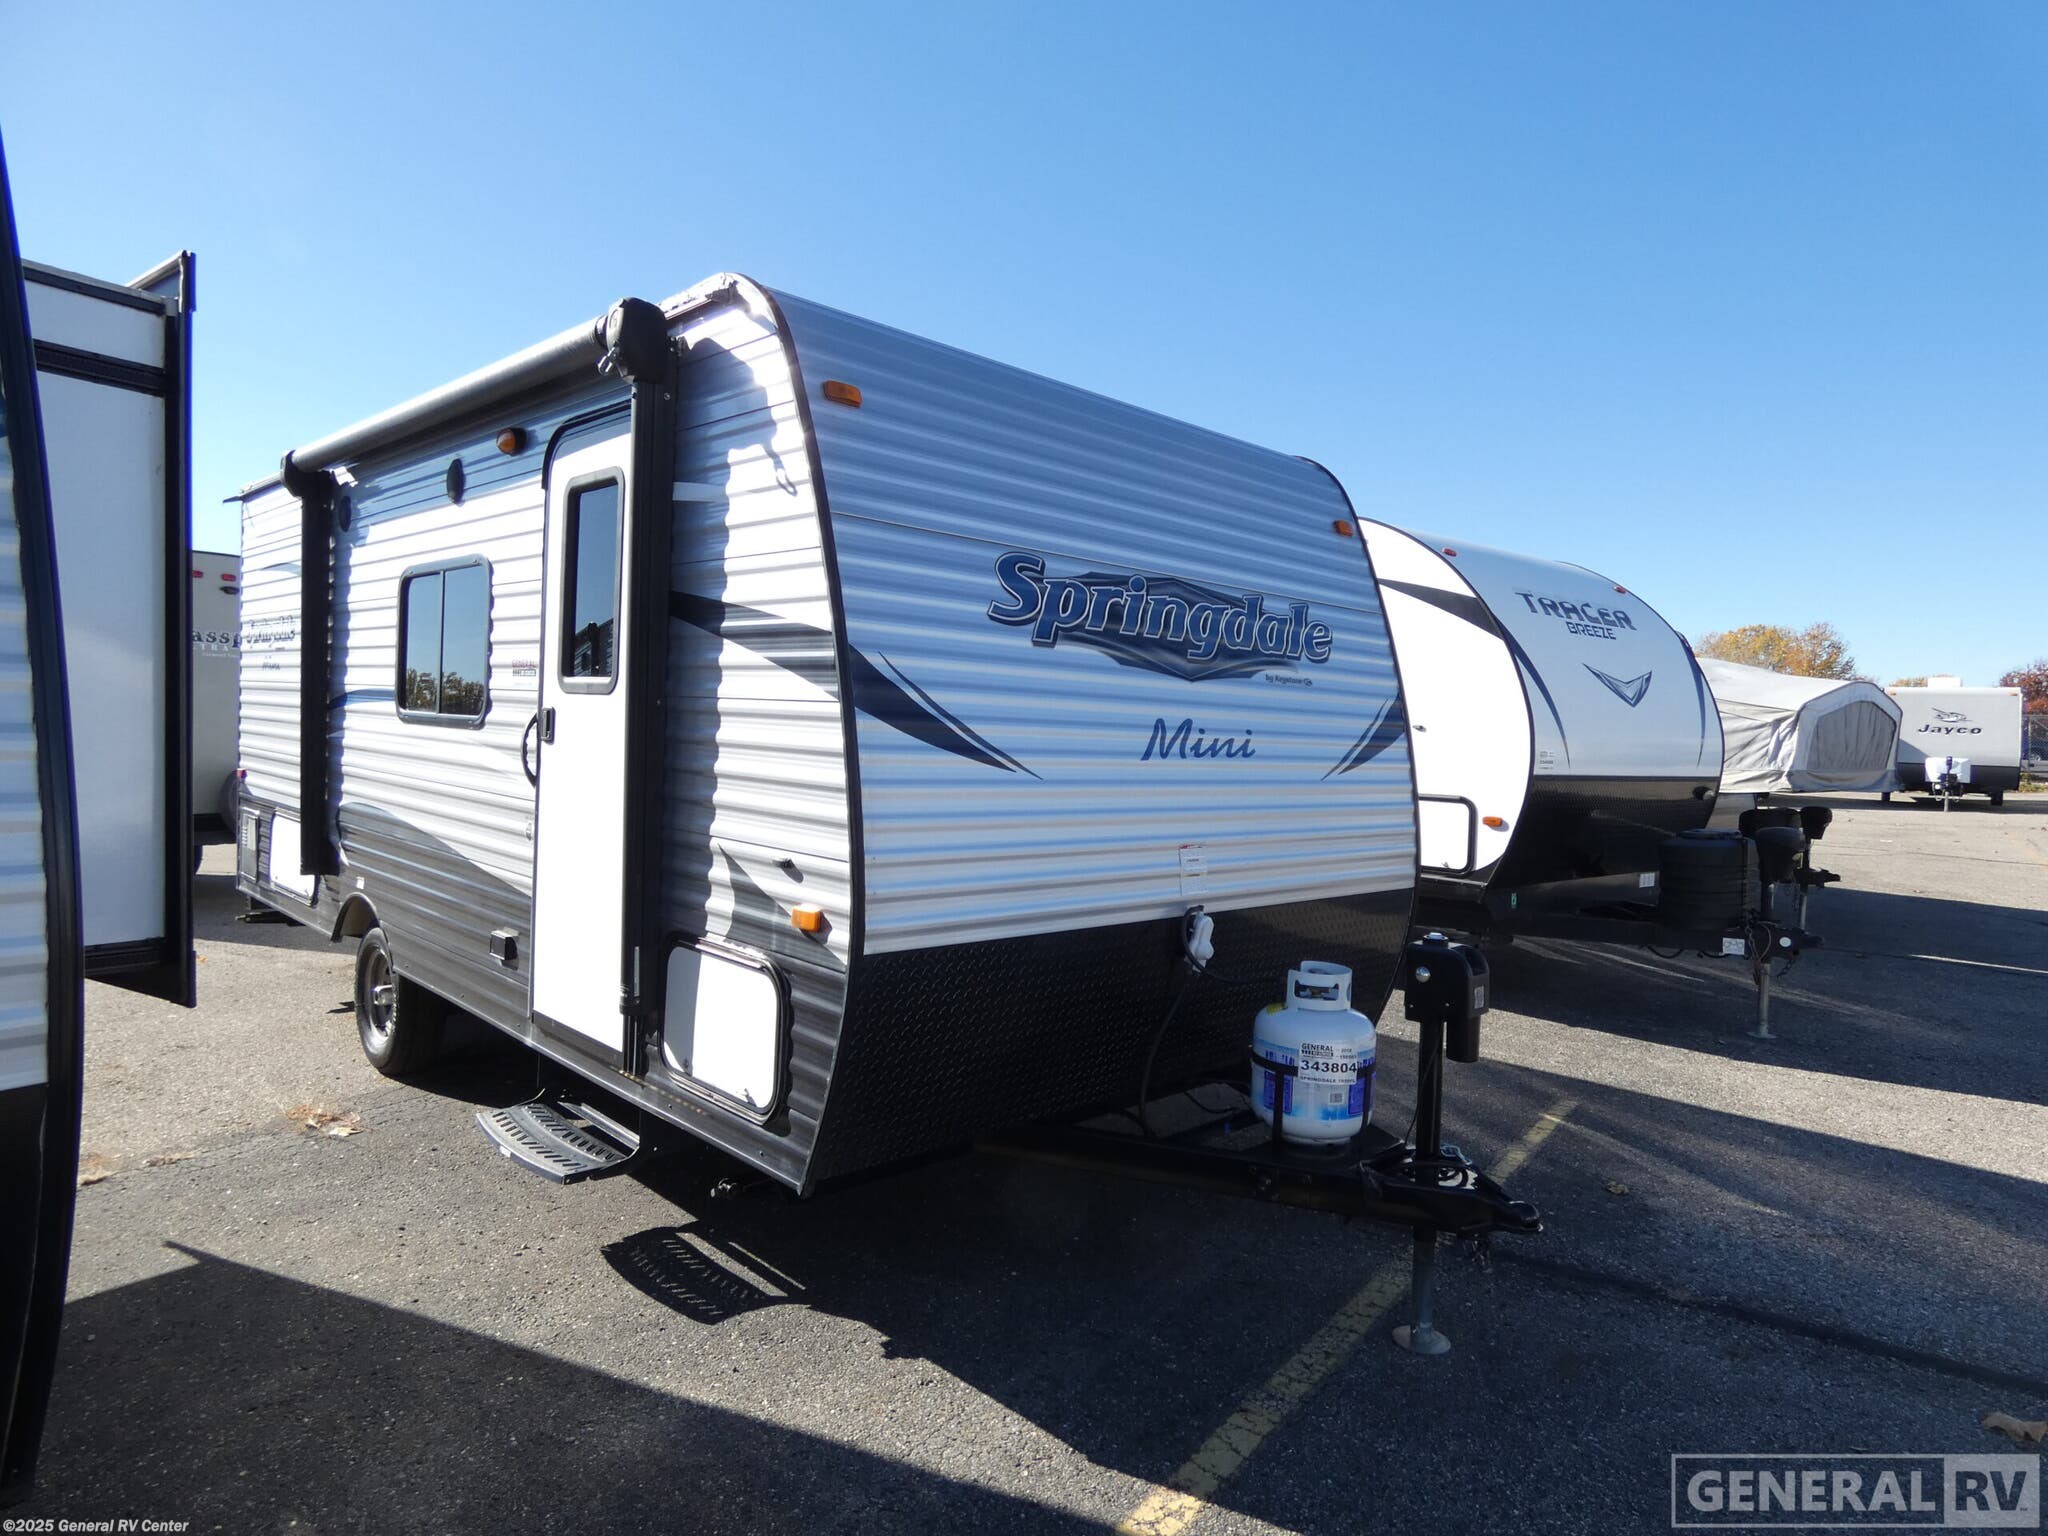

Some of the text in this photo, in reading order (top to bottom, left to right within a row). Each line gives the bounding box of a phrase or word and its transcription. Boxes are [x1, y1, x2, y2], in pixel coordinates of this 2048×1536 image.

[987, 551, 1333, 663] Springdale
[1515, 590, 1637, 631] TRACER
[1566, 621, 1616, 640] BREEZE
[1918, 724, 1982, 735] Jayco
[1140, 718, 1256, 761] Mini
[1301, 1043, 1333, 1052] GENERAL
[1300, 1060, 1357, 1073] 343804
